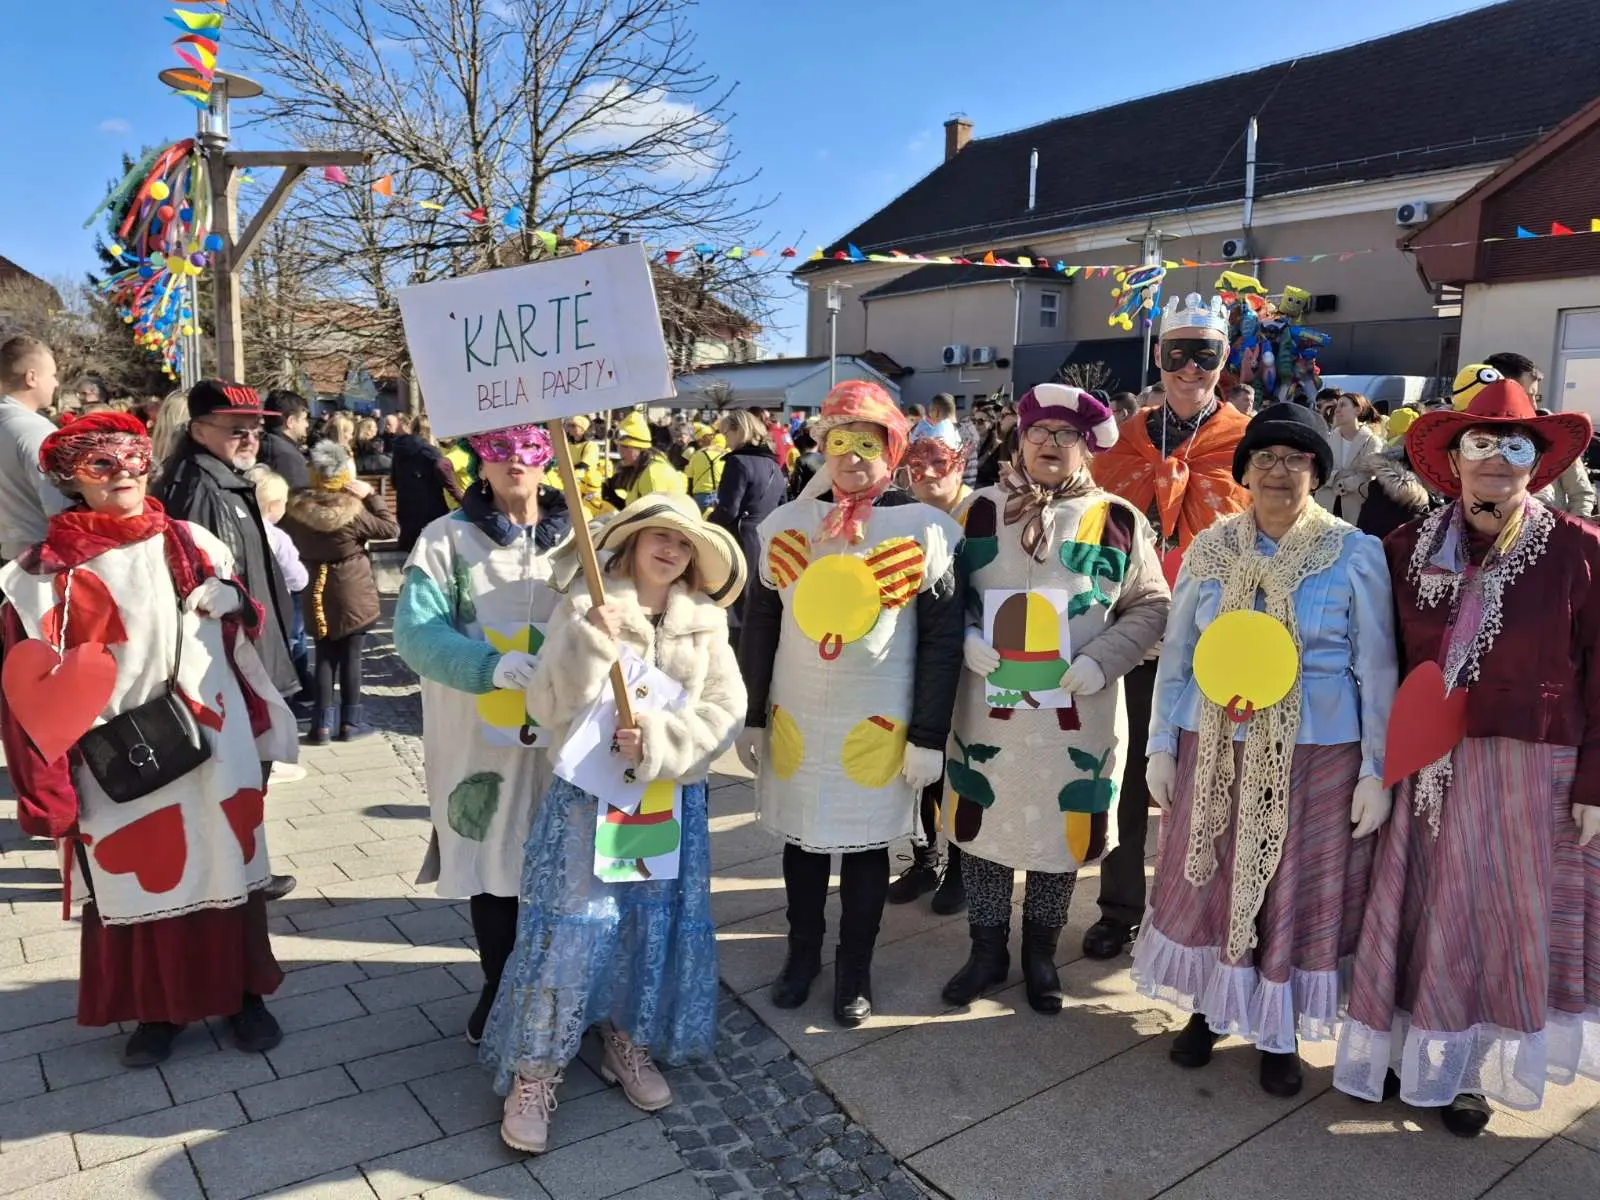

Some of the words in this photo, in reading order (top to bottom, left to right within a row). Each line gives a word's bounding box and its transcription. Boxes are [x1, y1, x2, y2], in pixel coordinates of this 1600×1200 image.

[464, 291, 595, 372] KARTE
[477, 376, 529, 411] BELA
[542, 358, 606, 399] PARTY
